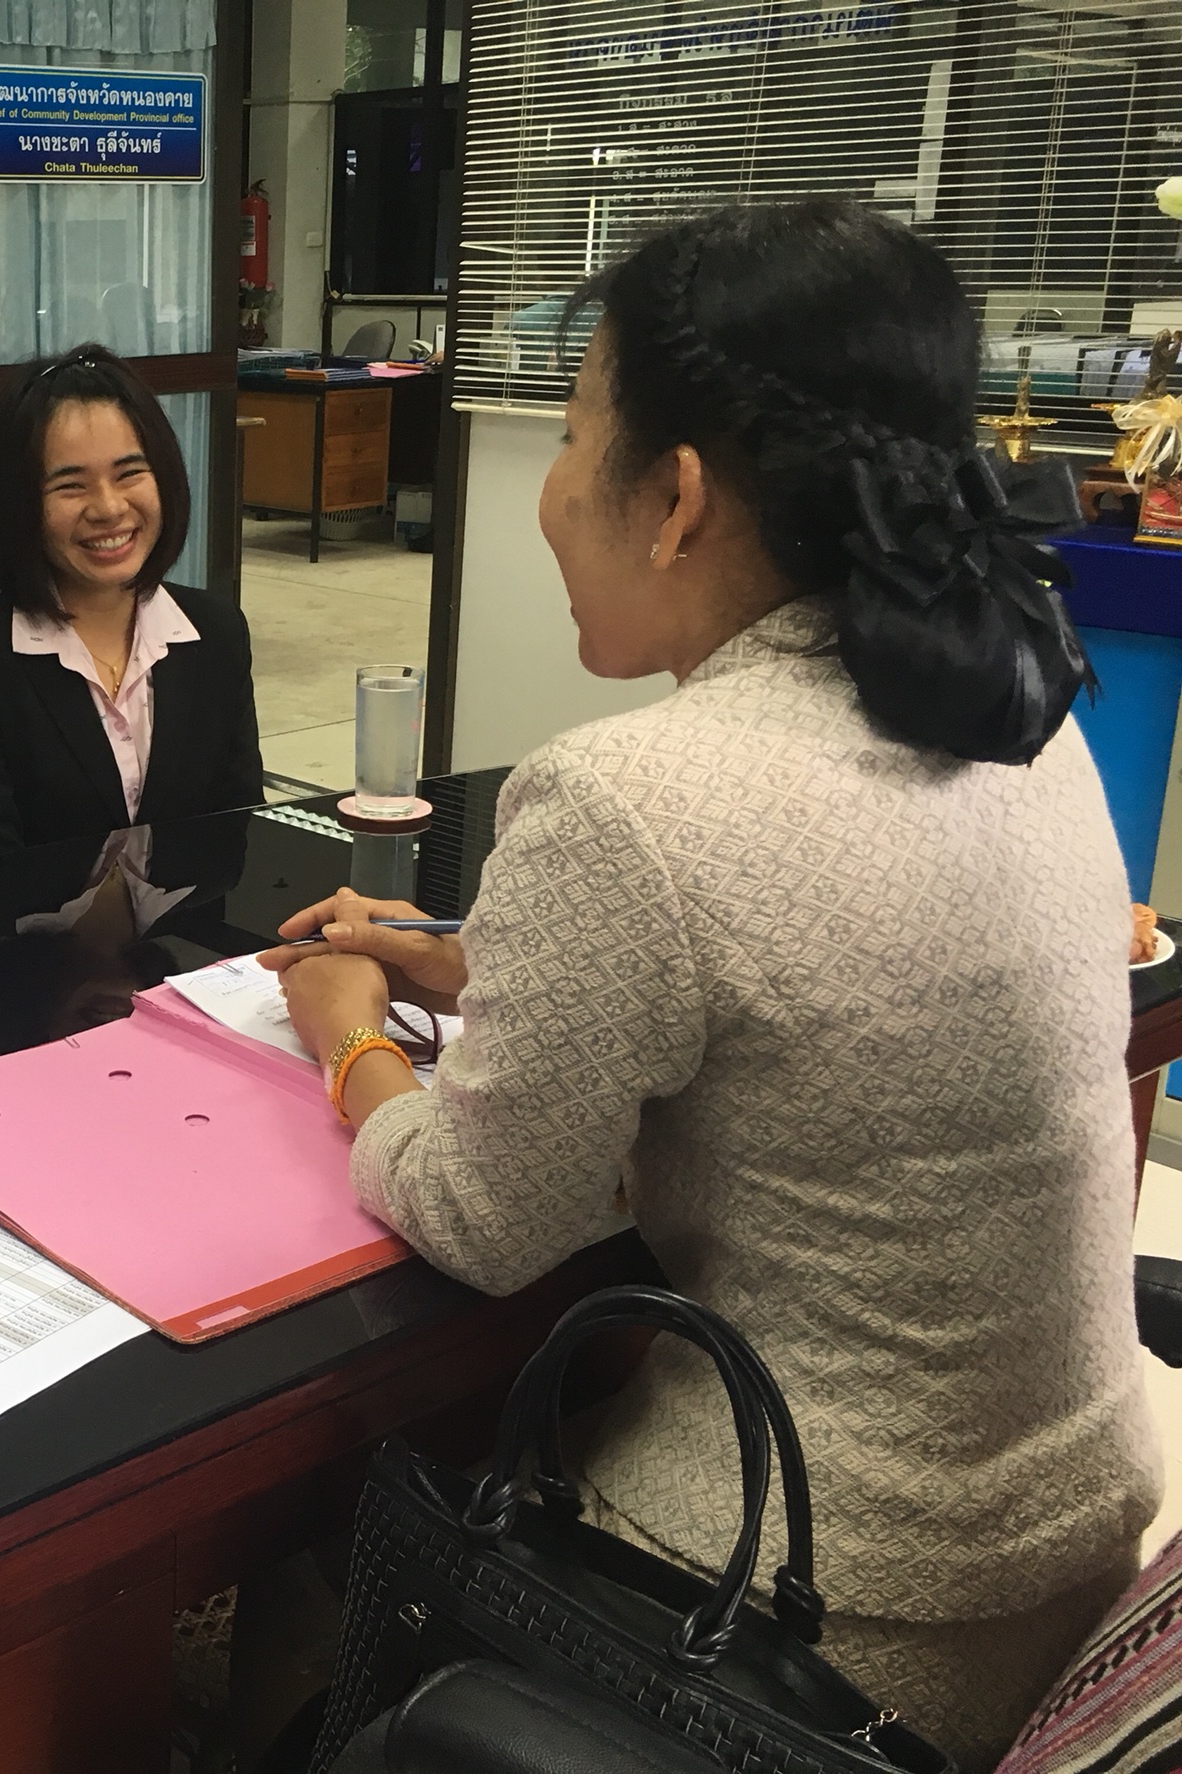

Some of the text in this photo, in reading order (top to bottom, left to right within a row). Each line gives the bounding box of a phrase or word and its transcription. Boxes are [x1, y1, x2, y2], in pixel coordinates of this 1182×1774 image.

[9, 108, 18, 118] of
[21, 108, 69, 121] Community
[73, 110, 127, 123] Development
[130, 111, 169, 123] Provincial
[172, 113, 194, 124] office
[18, 130, 162, 161] นางชะตา ธุลีจันทร์
[44, 162, 138, 174] Chata Thuleechan
